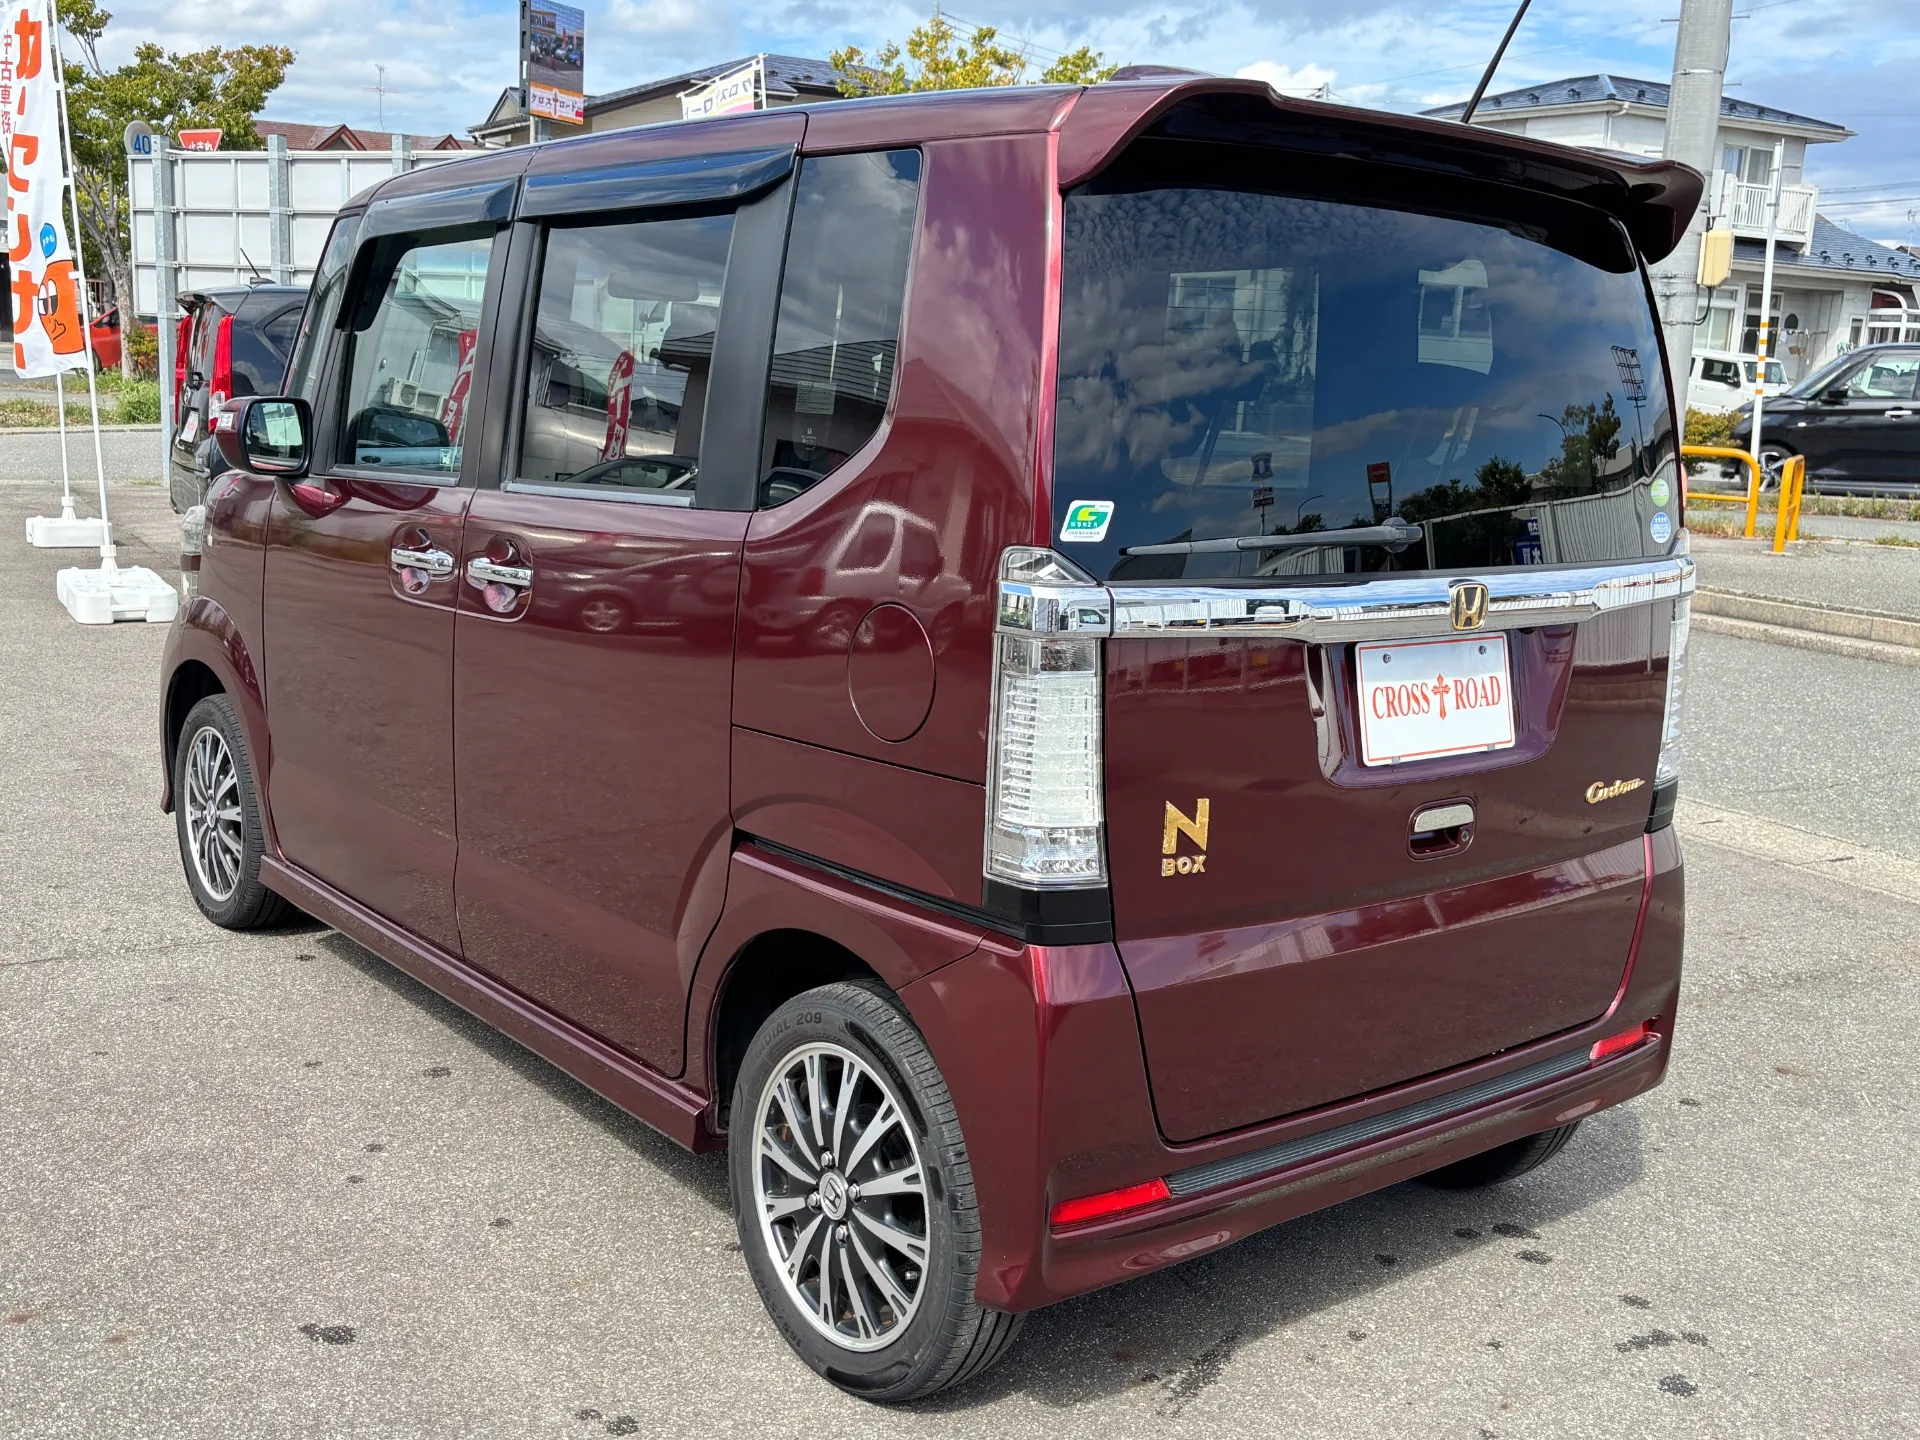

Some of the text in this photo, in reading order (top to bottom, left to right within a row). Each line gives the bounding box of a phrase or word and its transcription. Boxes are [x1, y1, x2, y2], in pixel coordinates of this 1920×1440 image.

[133, 133, 151, 154] 40
[1372, 676, 1501, 719] CROSS ROAD
[1585, 778, 1646, 804] Custom
[1162, 798, 1210, 855] N
[1161, 855, 1207, 877] BOX
[796, 1011, 822, 1026] 209
